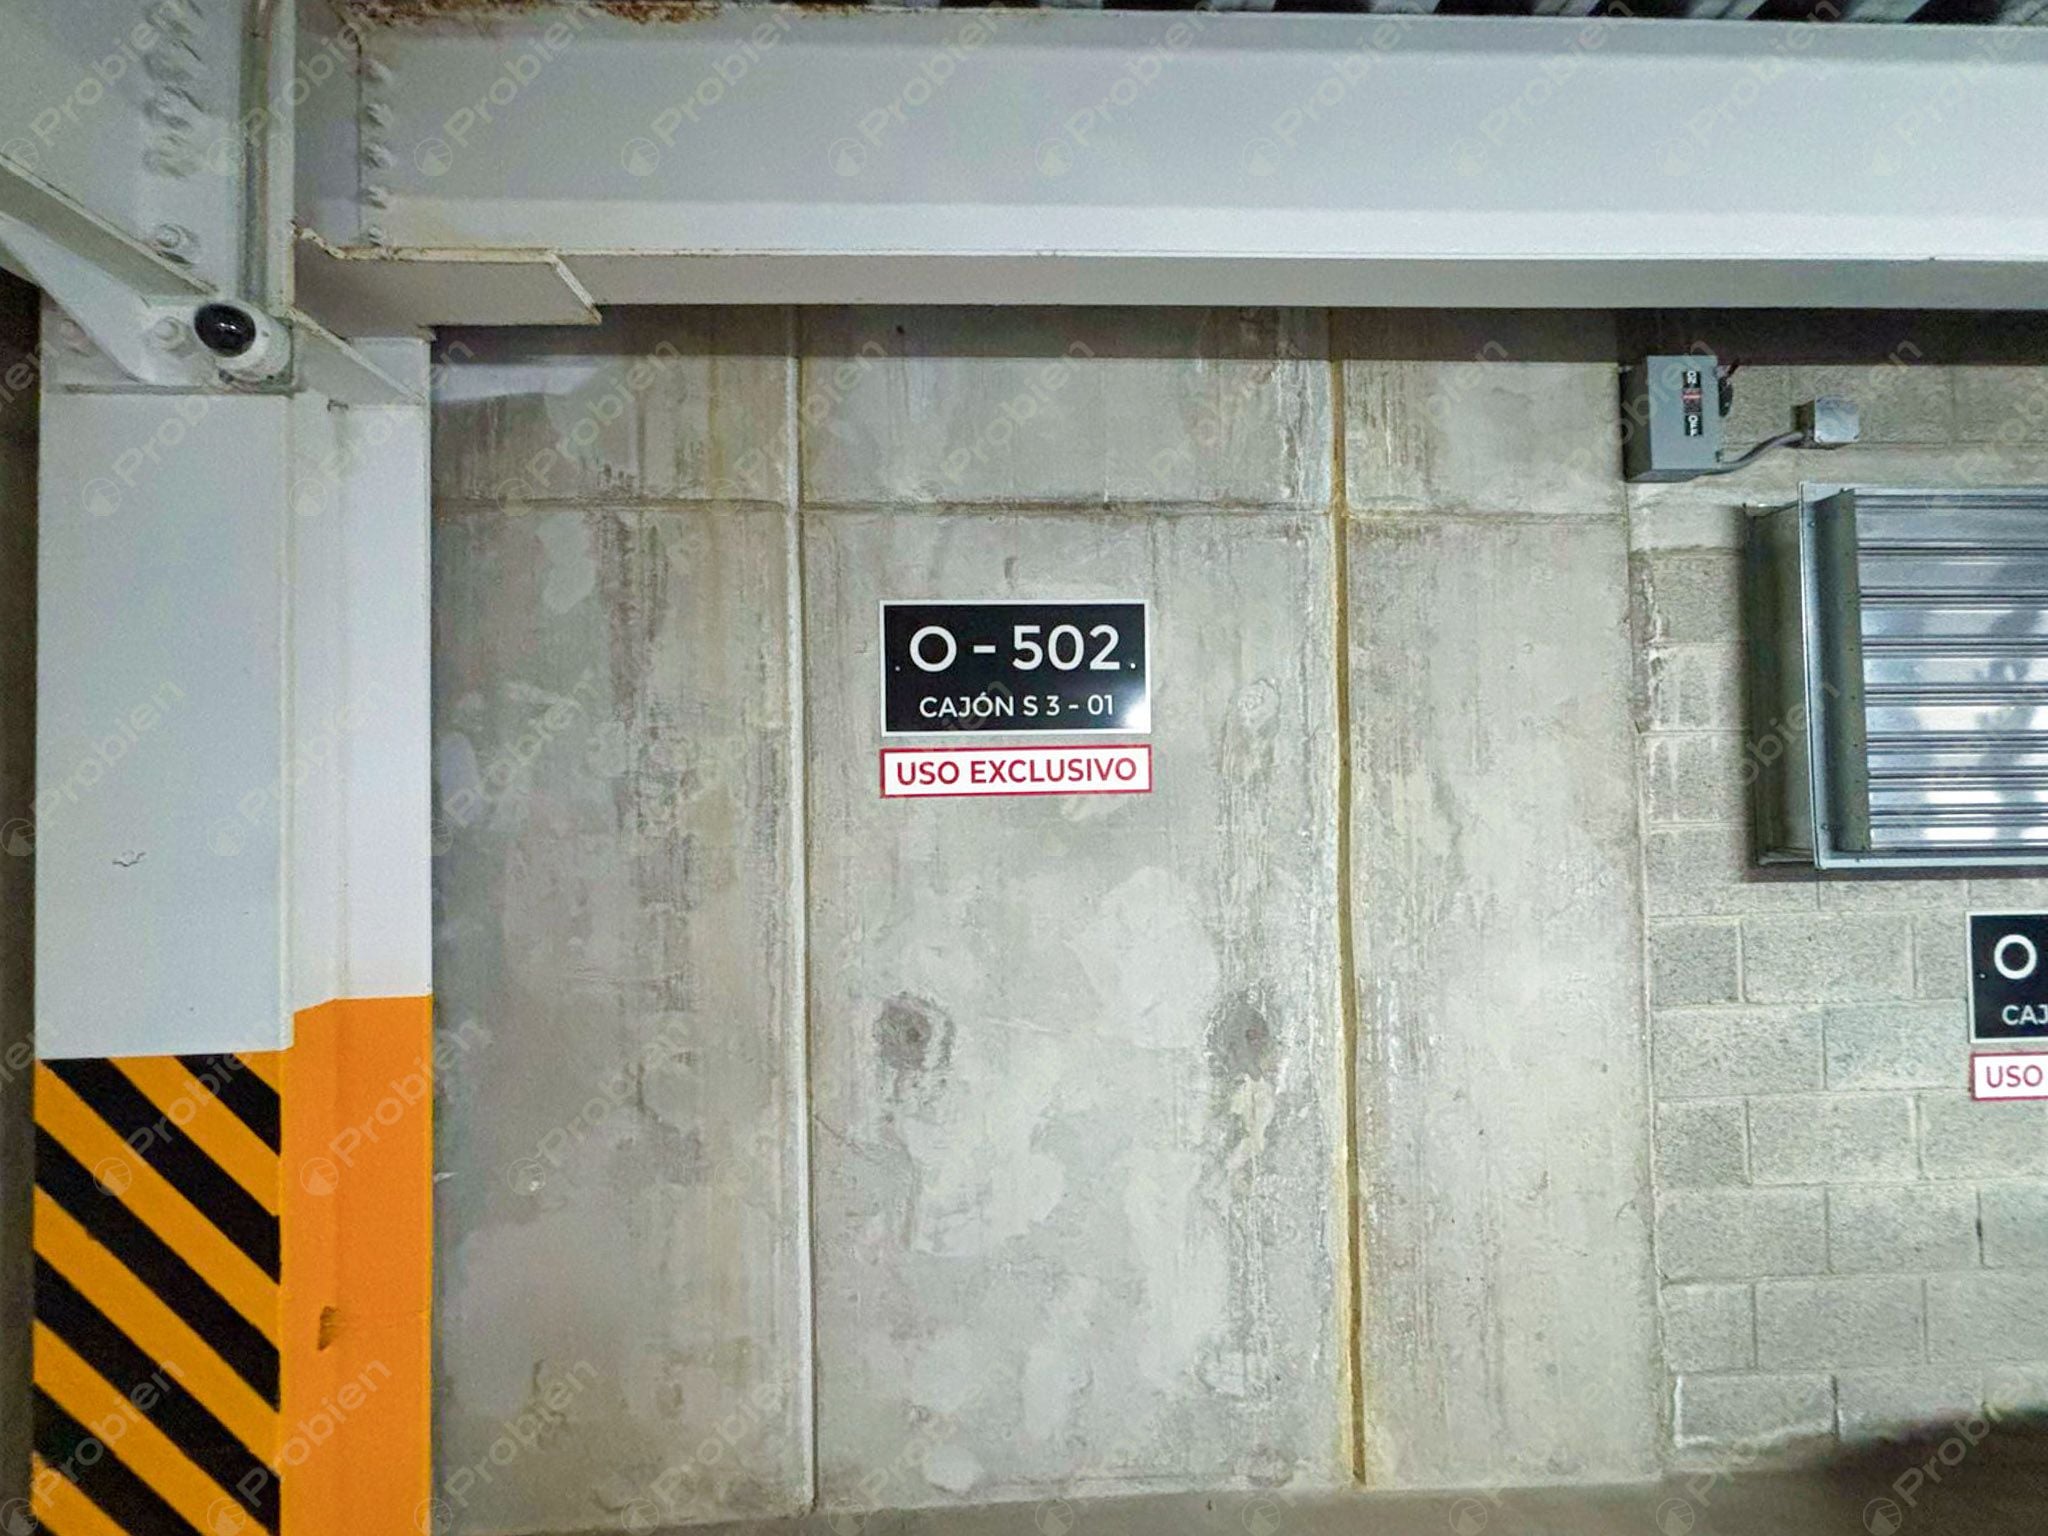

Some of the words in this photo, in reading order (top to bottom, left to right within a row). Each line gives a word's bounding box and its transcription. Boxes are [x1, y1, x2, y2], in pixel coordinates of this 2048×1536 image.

[909, 625, 957, 672] O
[1012, 624, 1121, 671] 502
[919, 692, 1014, 718] CAJÓN
[1023, 696, 1039, 716] S
[1046, 695, 1060, 716] 3
[1087, 694, 1114, 716] 01
[897, 760, 960, 785] USO
[970, 757, 1137, 783] EXCLUSIVO
[1994, 934, 2037, 980] O
[2002, 1004, 2048, 1026] CAJ
[1986, 1064, 2043, 1088] USO
